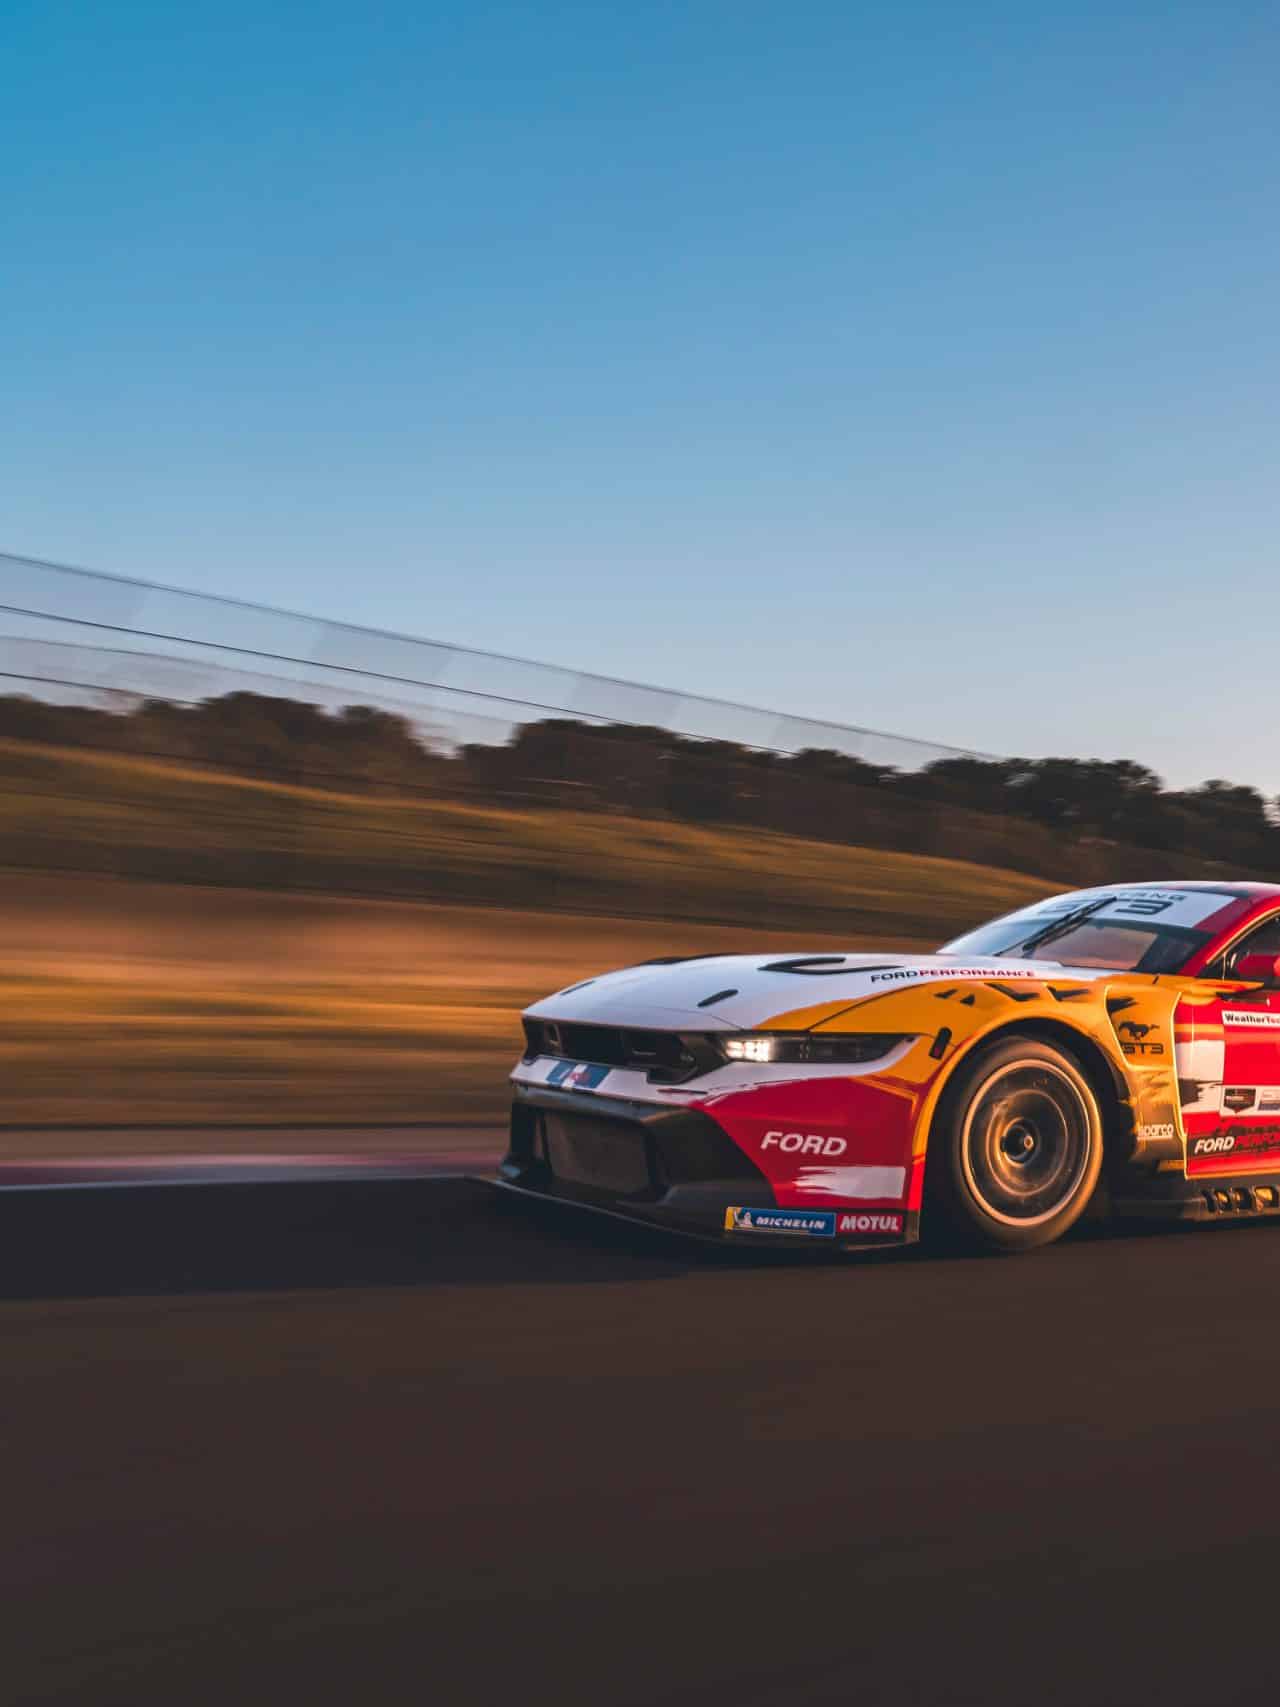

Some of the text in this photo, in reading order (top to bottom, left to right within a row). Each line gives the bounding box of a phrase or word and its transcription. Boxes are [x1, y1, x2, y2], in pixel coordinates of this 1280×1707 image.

[1038, 898, 1173, 916] G3
[760, 1131, 847, 1156] FORD
[756, 1216, 825, 1230] MICHELIN
[839, 1215, 899, 1232] MOTUL
